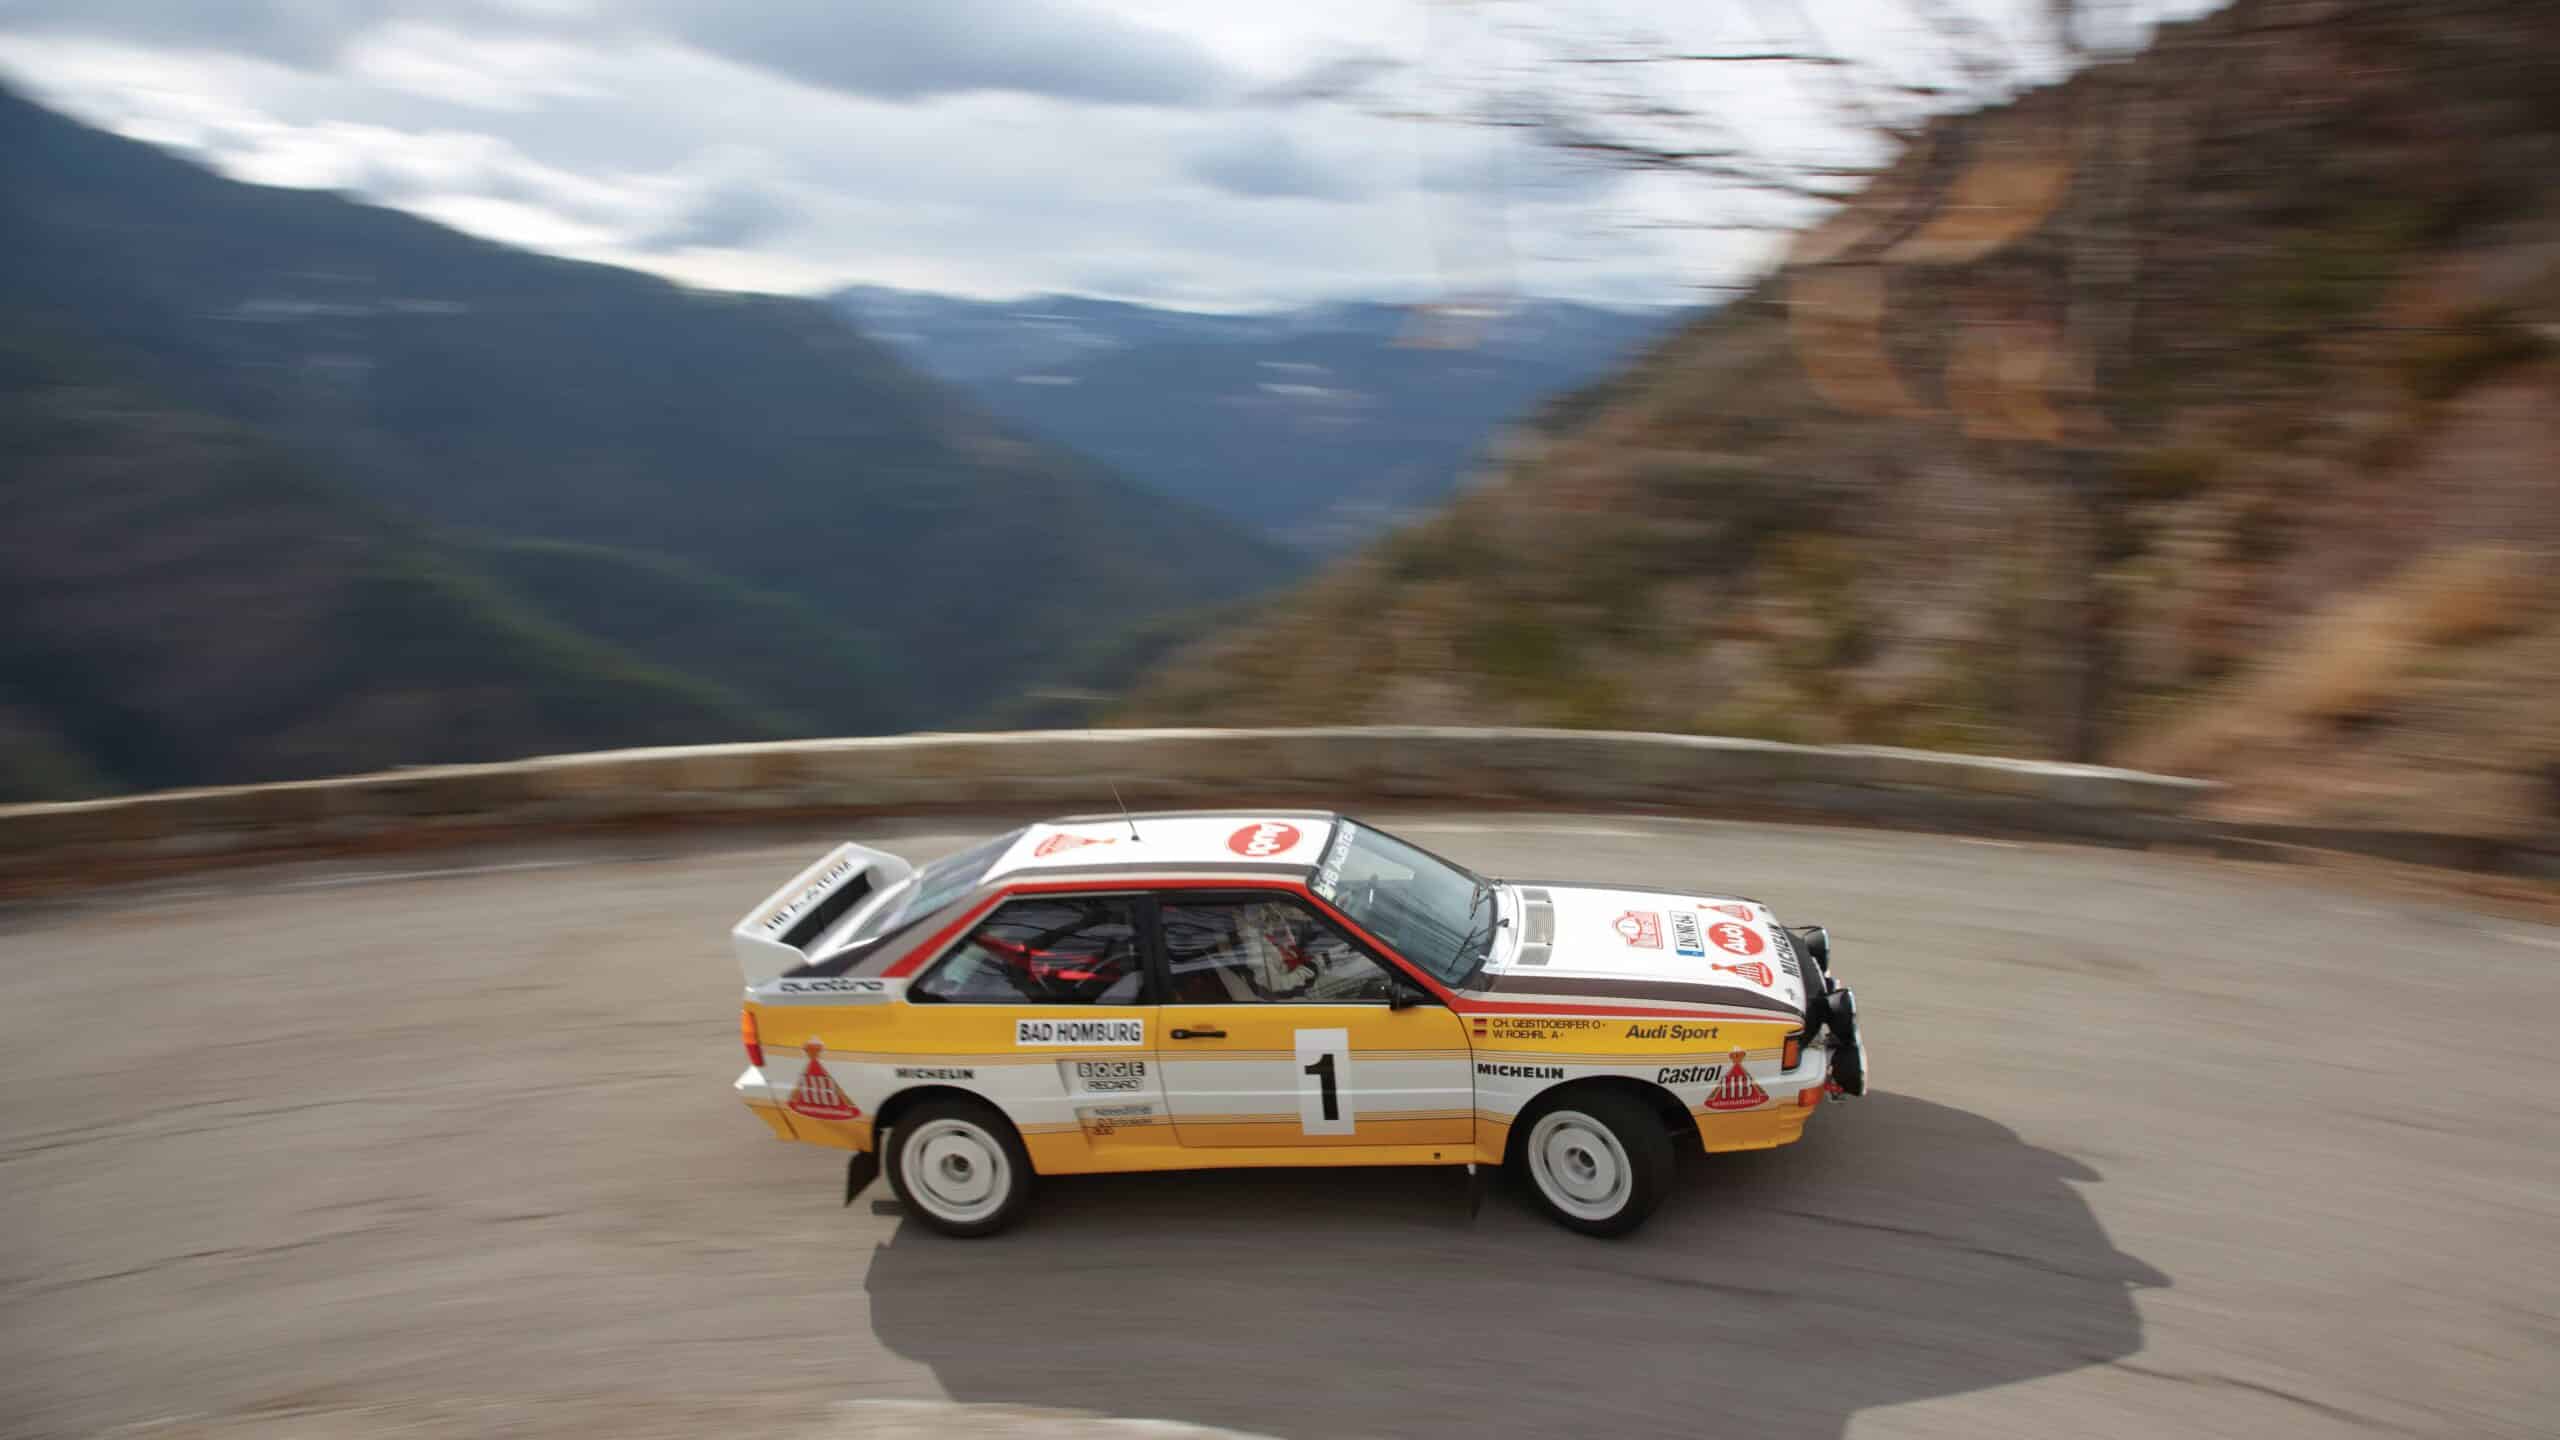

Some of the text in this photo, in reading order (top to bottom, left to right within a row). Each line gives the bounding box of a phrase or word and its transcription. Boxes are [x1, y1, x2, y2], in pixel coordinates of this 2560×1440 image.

[1247, 824, 1288, 855] Audi
[1721, 925, 1747, 953] Audi
[1767, 922, 1800, 978] MICHELIN
[780, 977, 884, 993] quattro
[1511, 1018, 1590, 1029] GEISTDOERFER
[1020, 1023, 1140, 1041] BAD HOMBURG
[1625, 1025, 1719, 1041] Audi Sport
[895, 1068, 974, 1080] MICHELIN
[1078, 1061, 1144, 1077] BOGE
[1477, 1063, 1564, 1078] MICHELIN
[1657, 1065, 1722, 1084] Castrol
[1087, 1079, 1139, 1090] RECARO
[1304, 1054, 1339, 1120] 1
